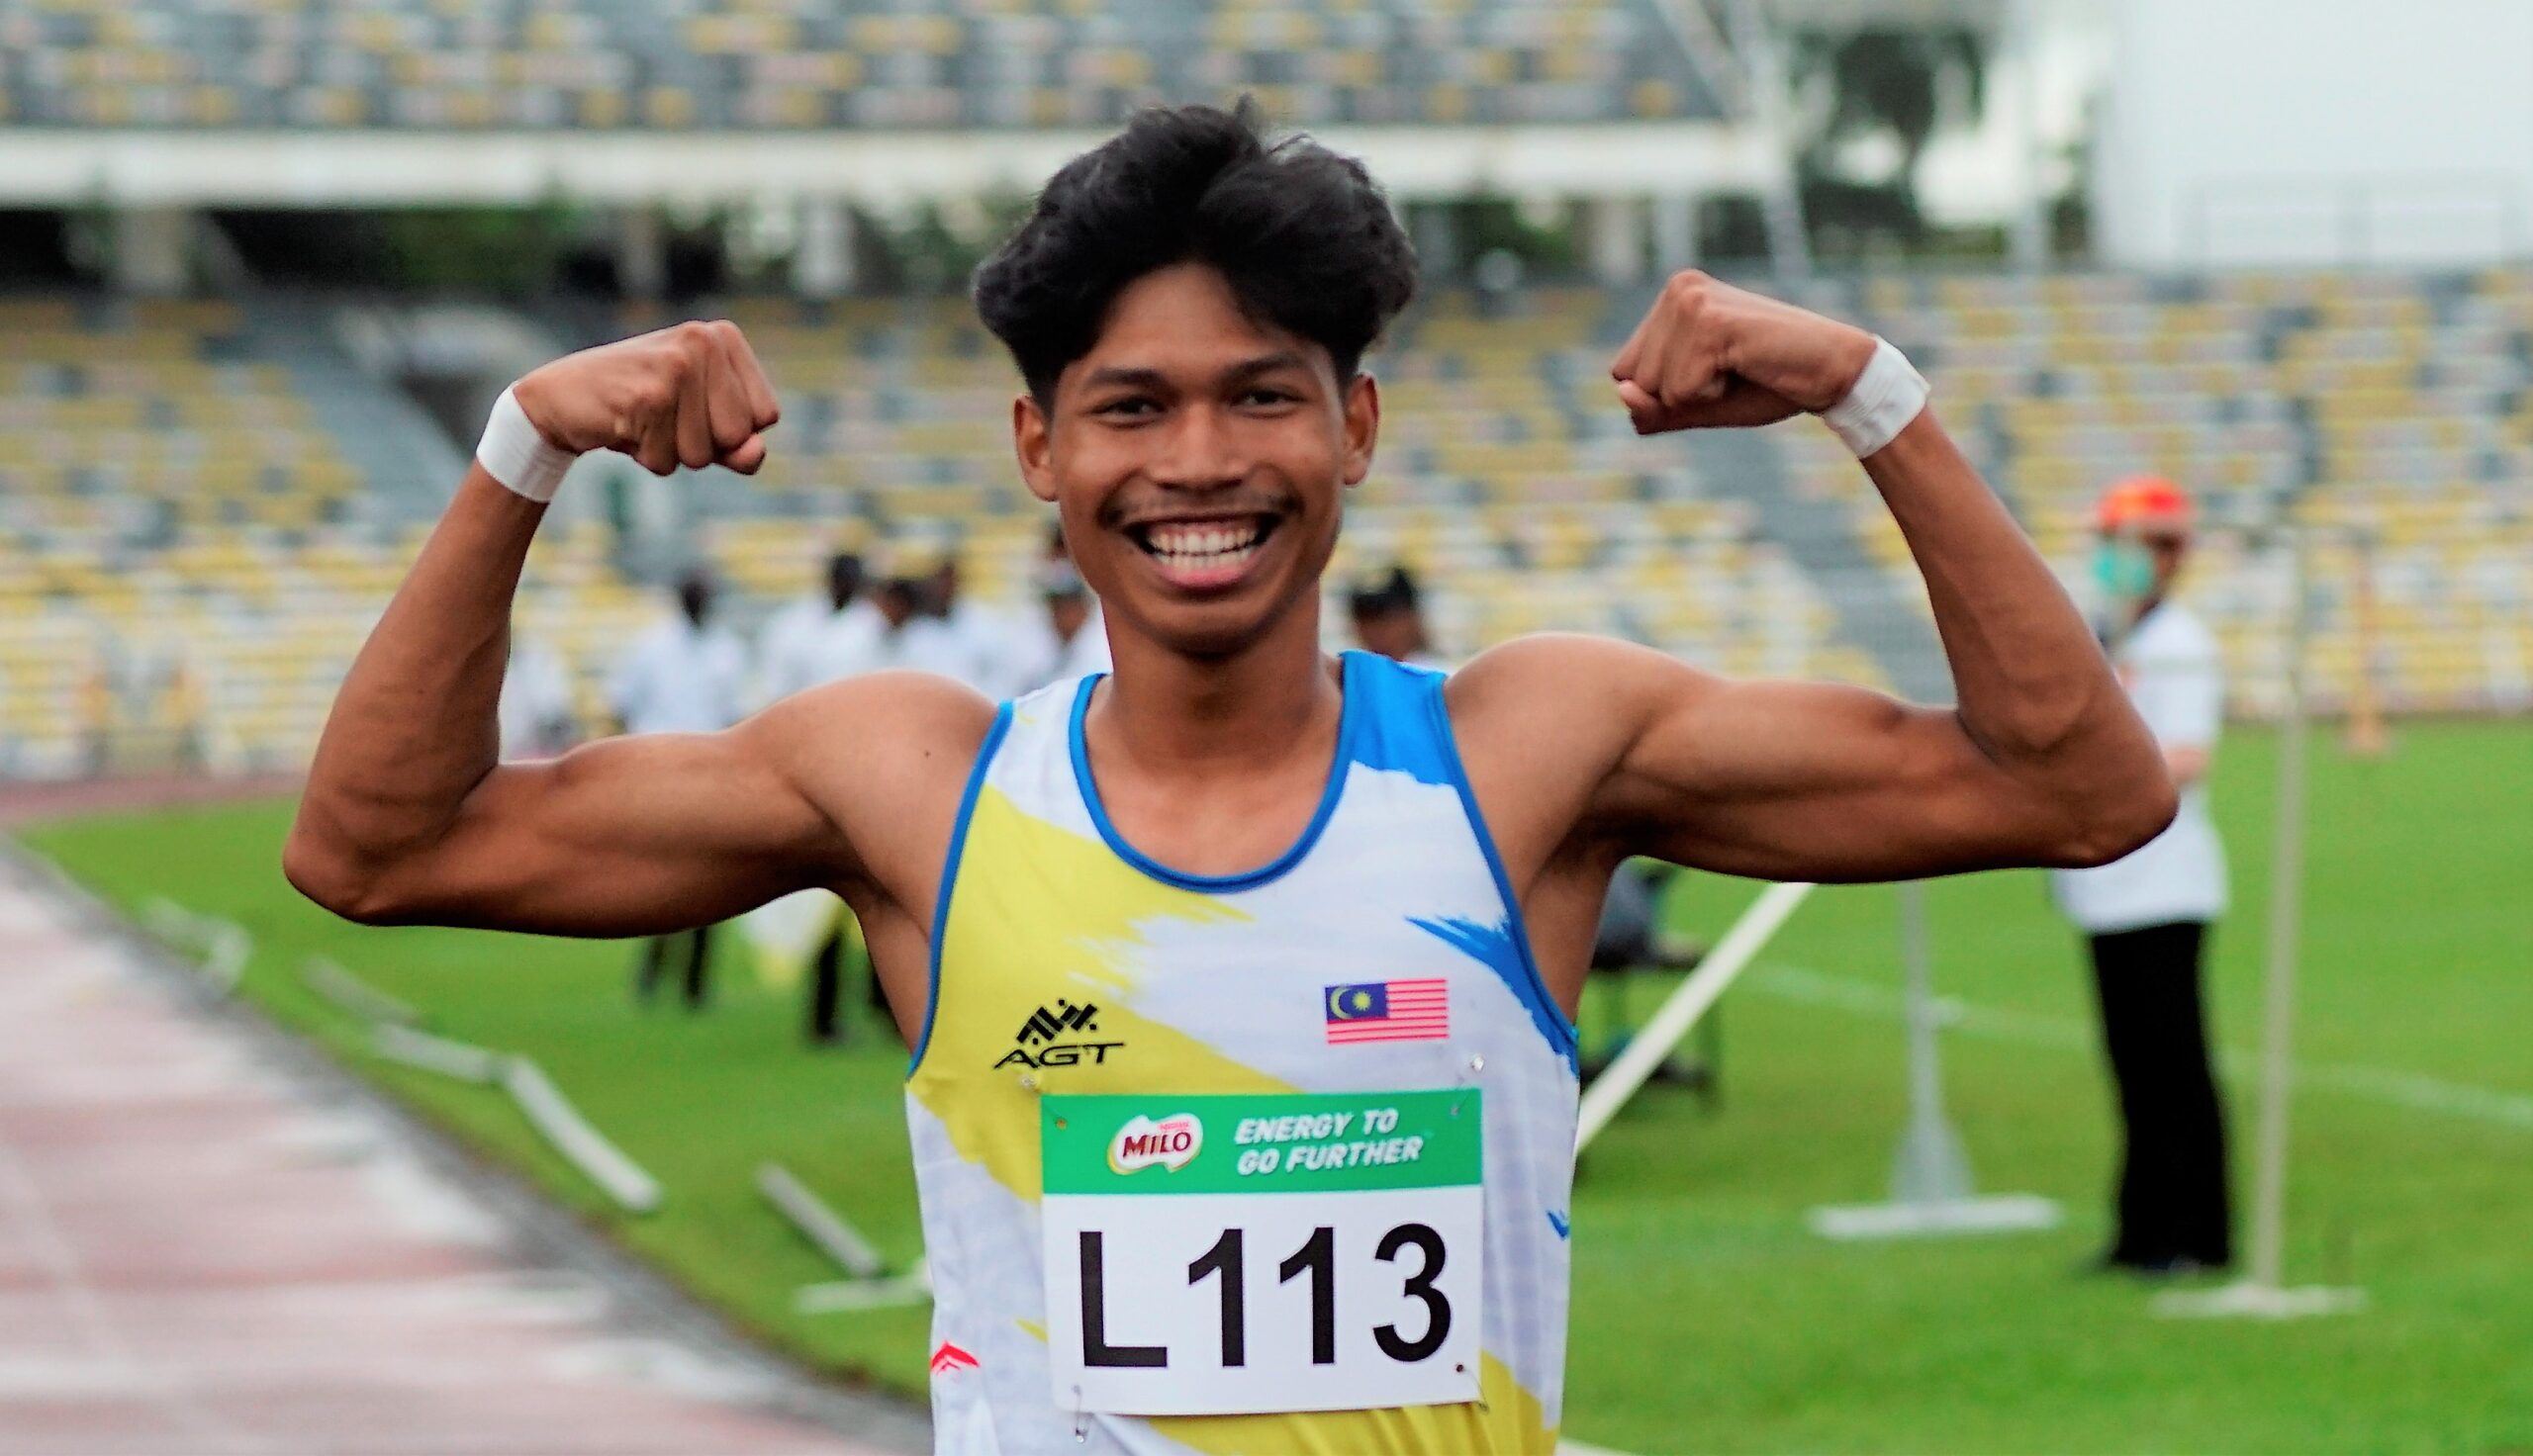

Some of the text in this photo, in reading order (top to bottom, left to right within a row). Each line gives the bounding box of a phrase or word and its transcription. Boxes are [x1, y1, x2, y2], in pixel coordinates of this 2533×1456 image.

[992, 1043, 1124, 1068] AGT
[1235, 1108, 1399, 1144] ENERGY TO
[1122, 1132, 1191, 1157] MILO
[1238, 1136, 1424, 1176] GO FURTHER
[1079, 1223, 1452, 1367] L113
